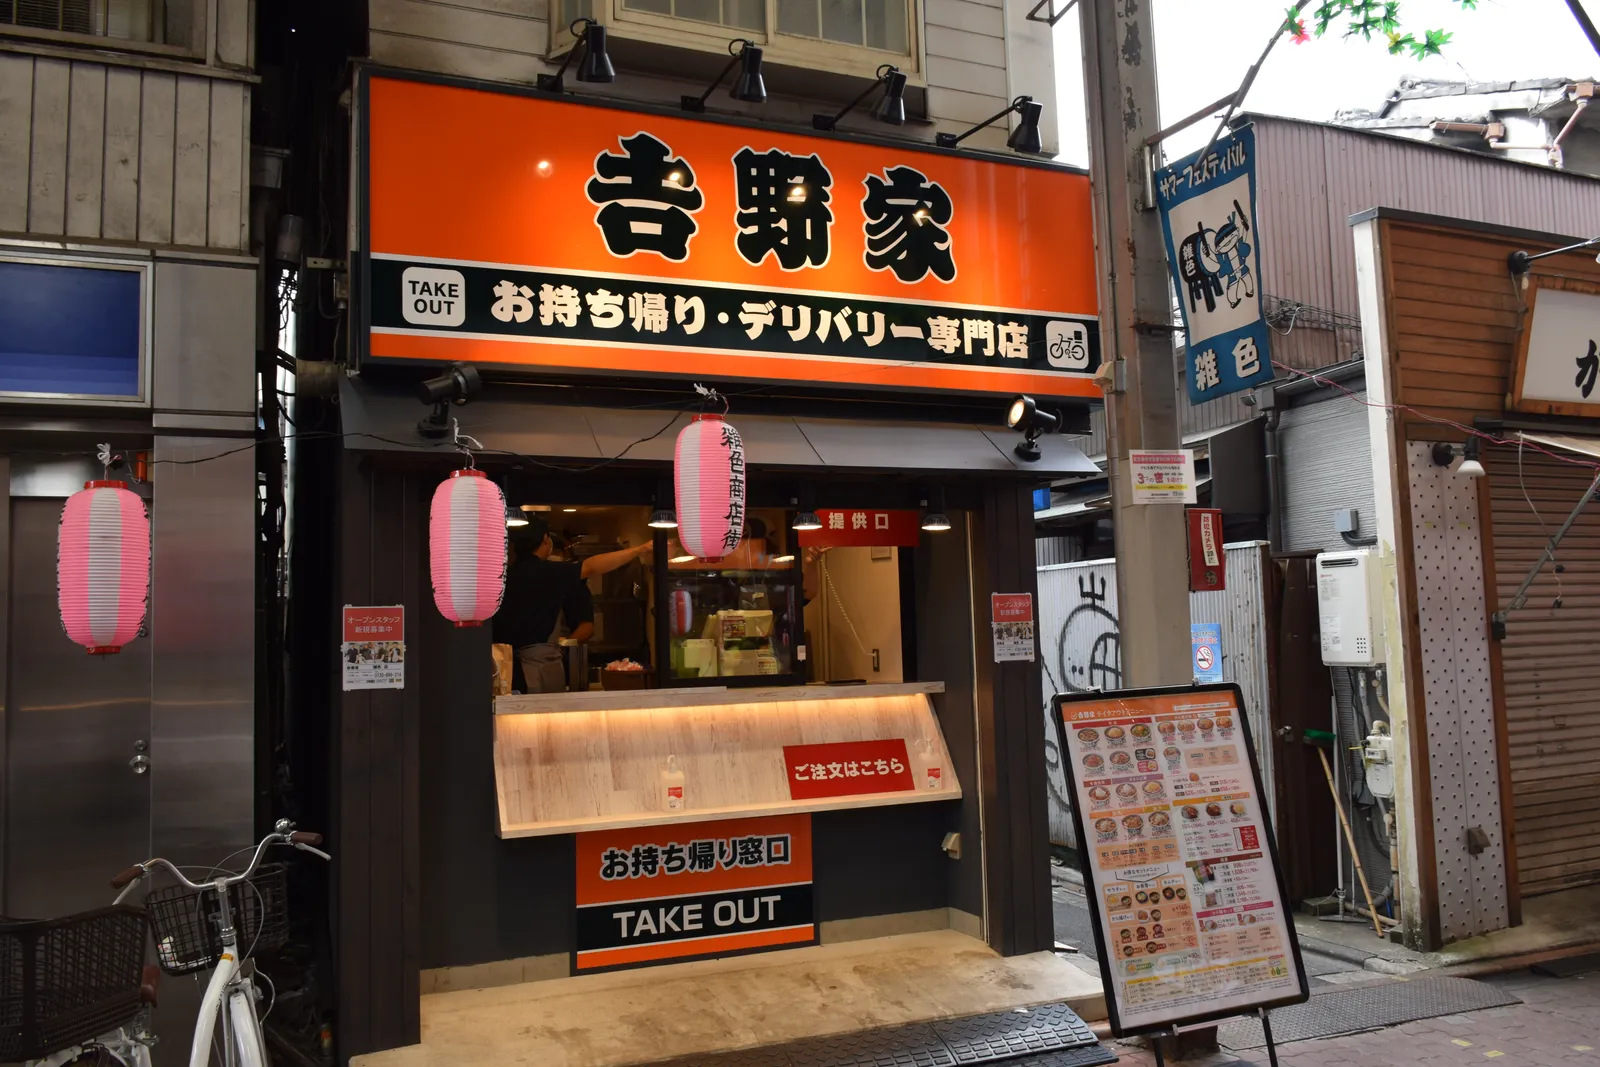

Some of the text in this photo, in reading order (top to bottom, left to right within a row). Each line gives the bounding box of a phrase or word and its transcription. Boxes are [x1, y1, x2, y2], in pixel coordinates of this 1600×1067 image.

[1159, 141, 1247, 202] サマーフェスティバル
[1182, 242, 1197, 277] 雑色
[408, 280, 459, 298] TAKE
[413, 298, 455, 315] OUT
[491, 278, 1029, 359] お持ち帰り・デリバリー専門店
[1194, 336, 1261, 392] 雑色
[720, 425, 745, 550] 雑色商店街
[828, 512, 889, 530] 提供口
[347, 616, 400, 624] オープンスタッフ
[794, 757, 904, 781] ご注文はこちら
[600, 833, 792, 882] お持ち帰り窓口
[613, 894, 781, 938] TAKE OUT
